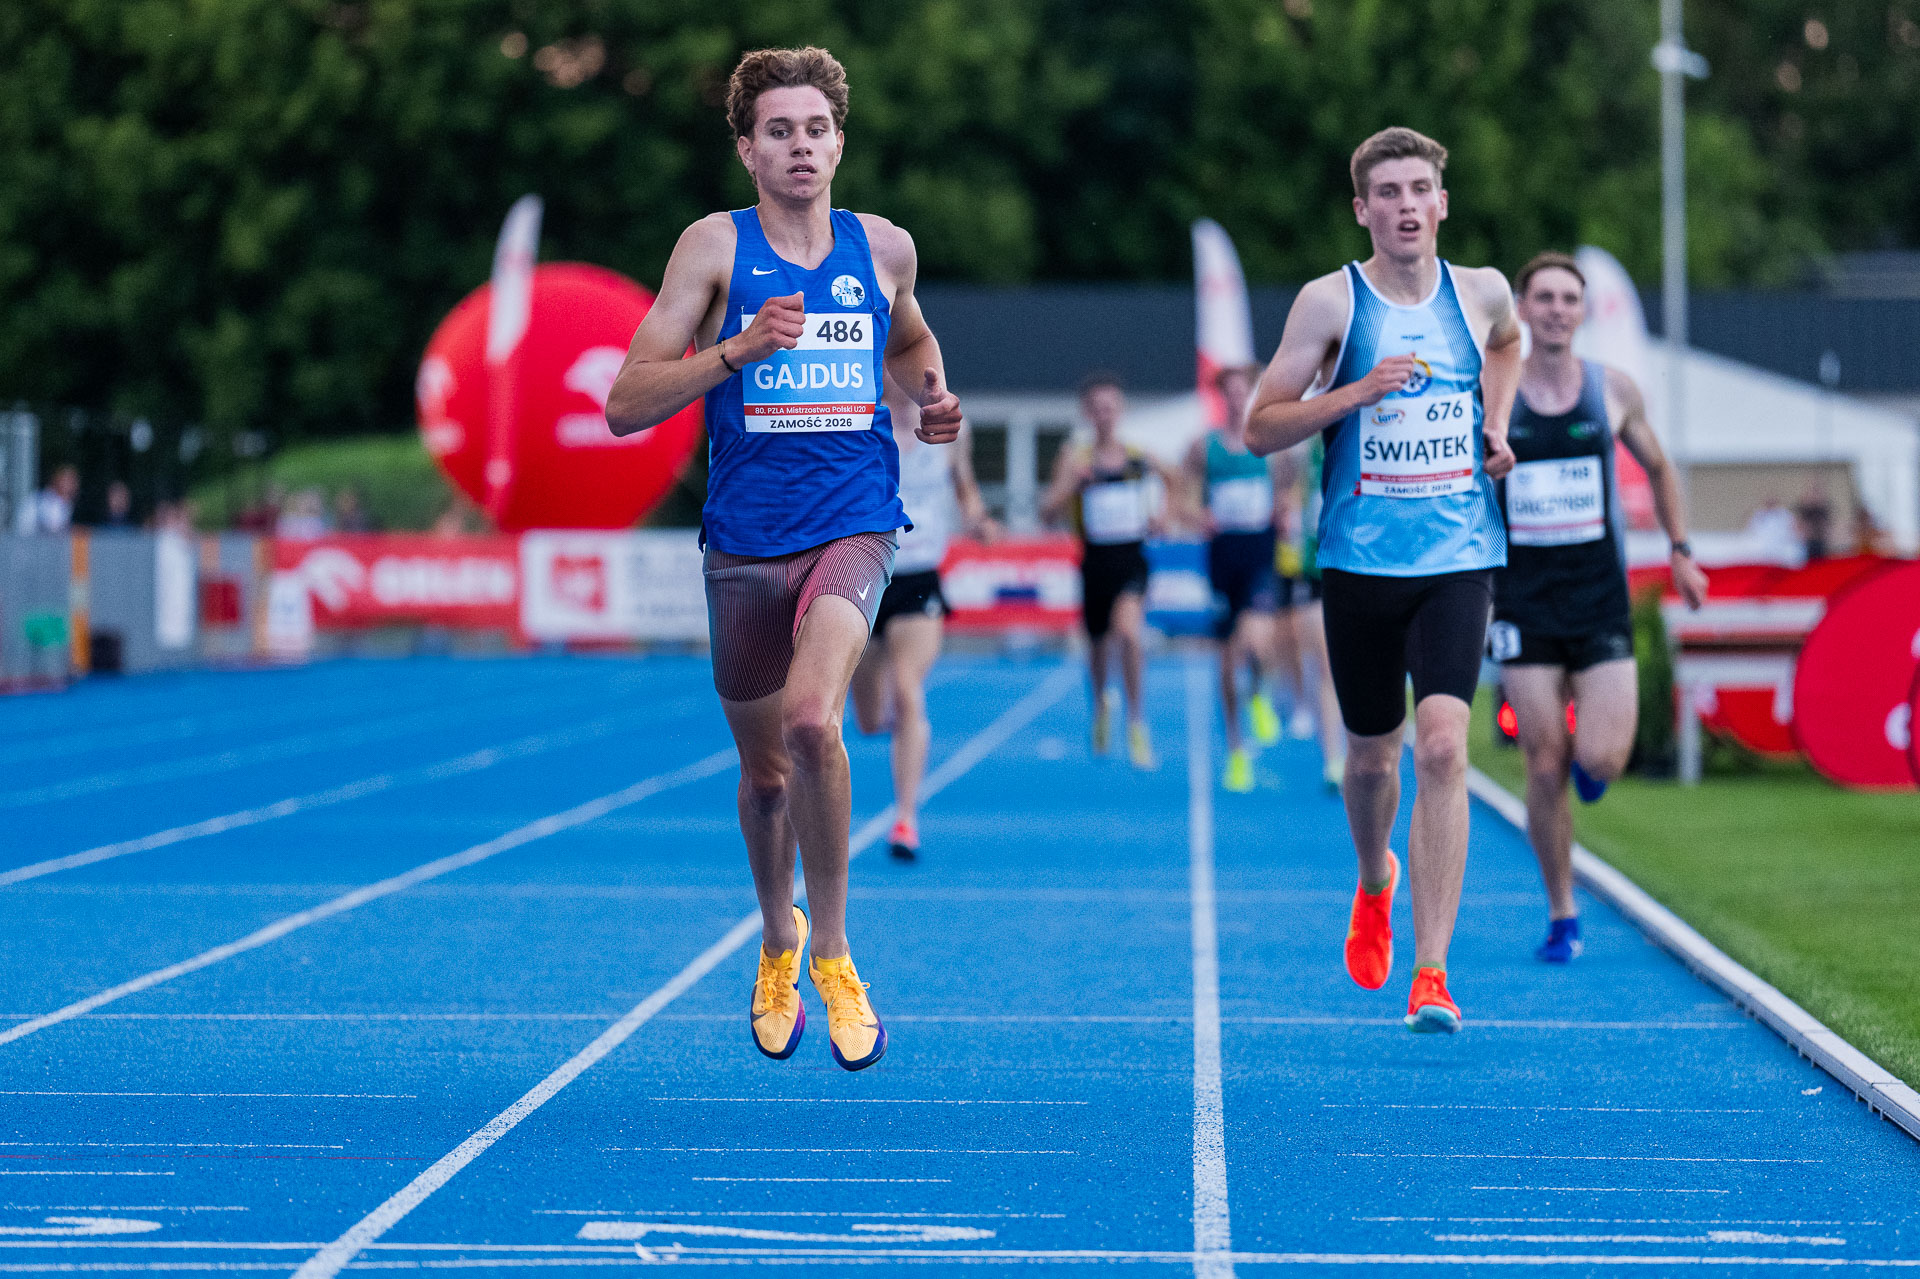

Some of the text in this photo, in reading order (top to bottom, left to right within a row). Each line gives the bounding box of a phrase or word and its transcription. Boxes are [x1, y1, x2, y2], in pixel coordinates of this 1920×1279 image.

[816, 320, 863, 343] 486
[754, 362, 863, 390] GAJDUS
[786, 406, 831, 414] Mistrzostwa
[832, 405, 853, 413] Polski
[854, 405, 866, 413] U20
[1426, 401, 1463, 421] 676
[770, 416, 853, 429] ZAMOŚĆ 2026
[1364, 435, 1468, 465] ŚWIĄTEK
